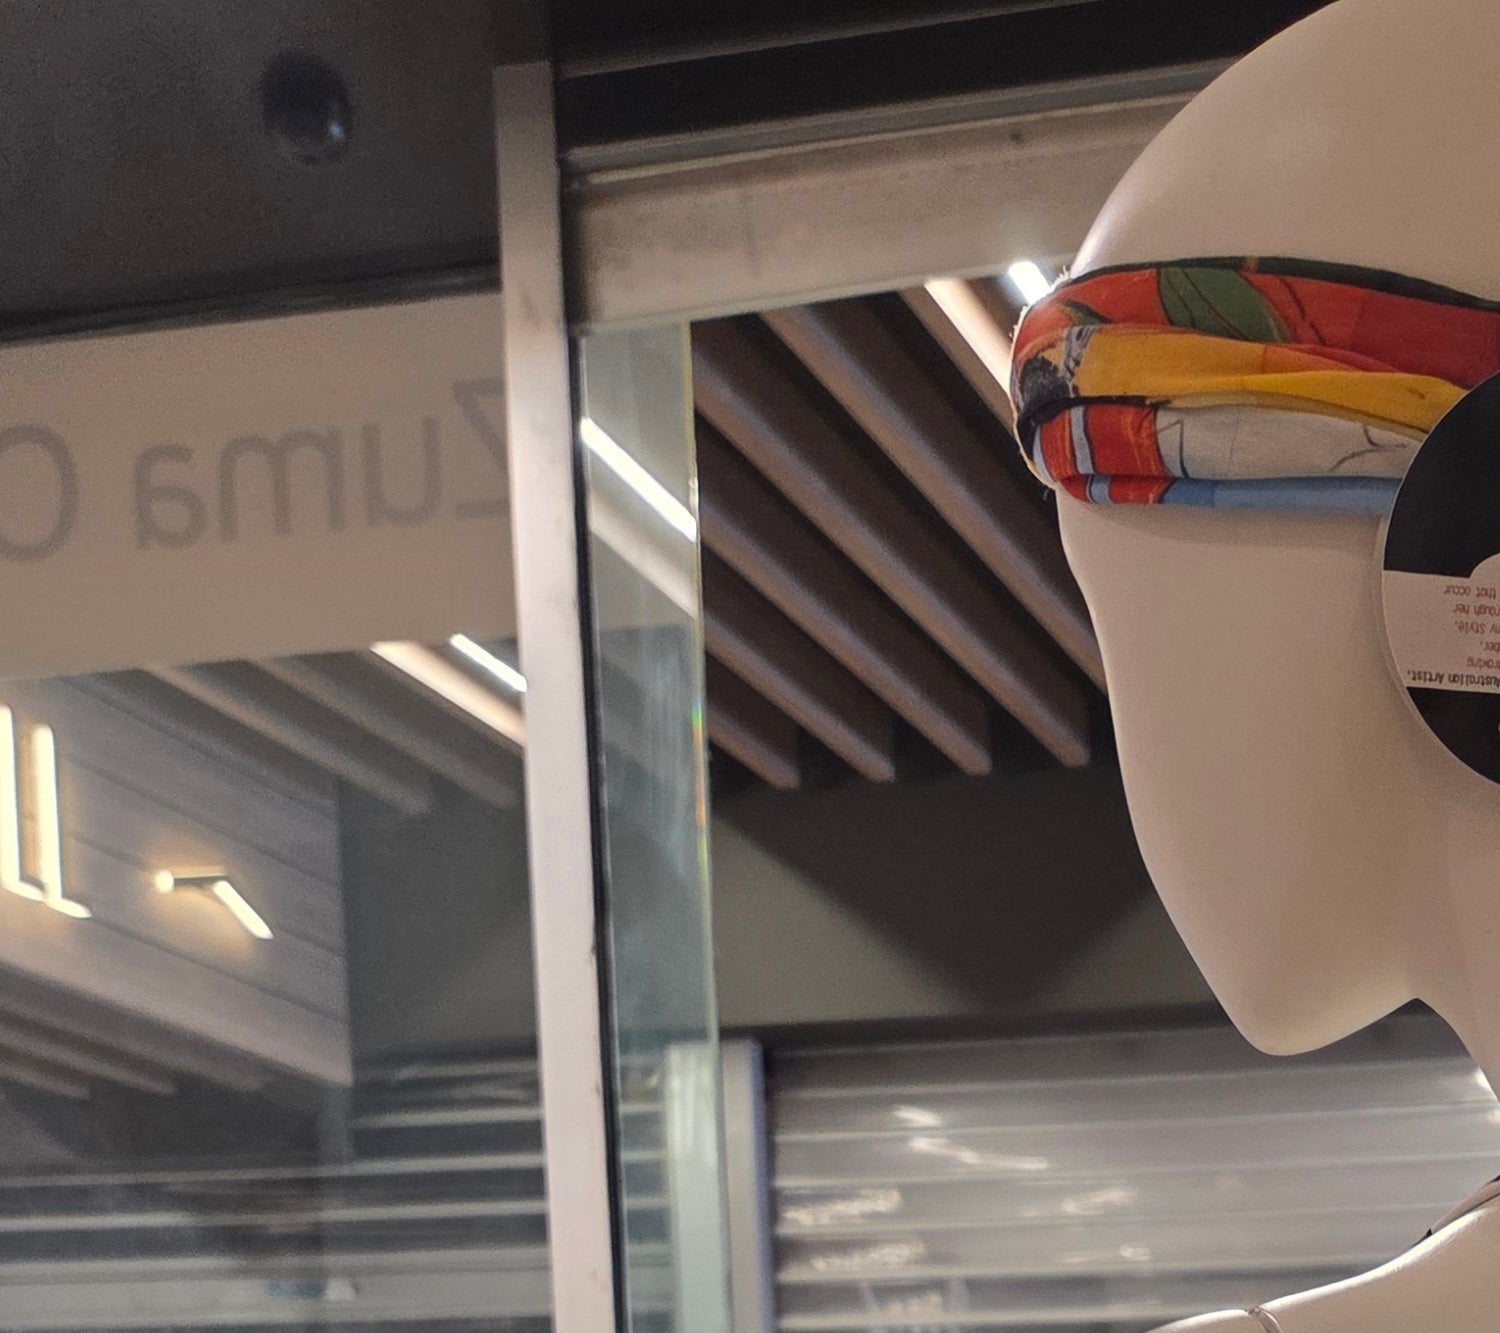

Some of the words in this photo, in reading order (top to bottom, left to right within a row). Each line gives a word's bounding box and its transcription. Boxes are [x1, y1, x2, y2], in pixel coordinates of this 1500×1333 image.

[1476, 587, 1496, 599] that
[1407, 670, 1444, 684] Artist.
[1449, 674, 1500, 688] Australian
